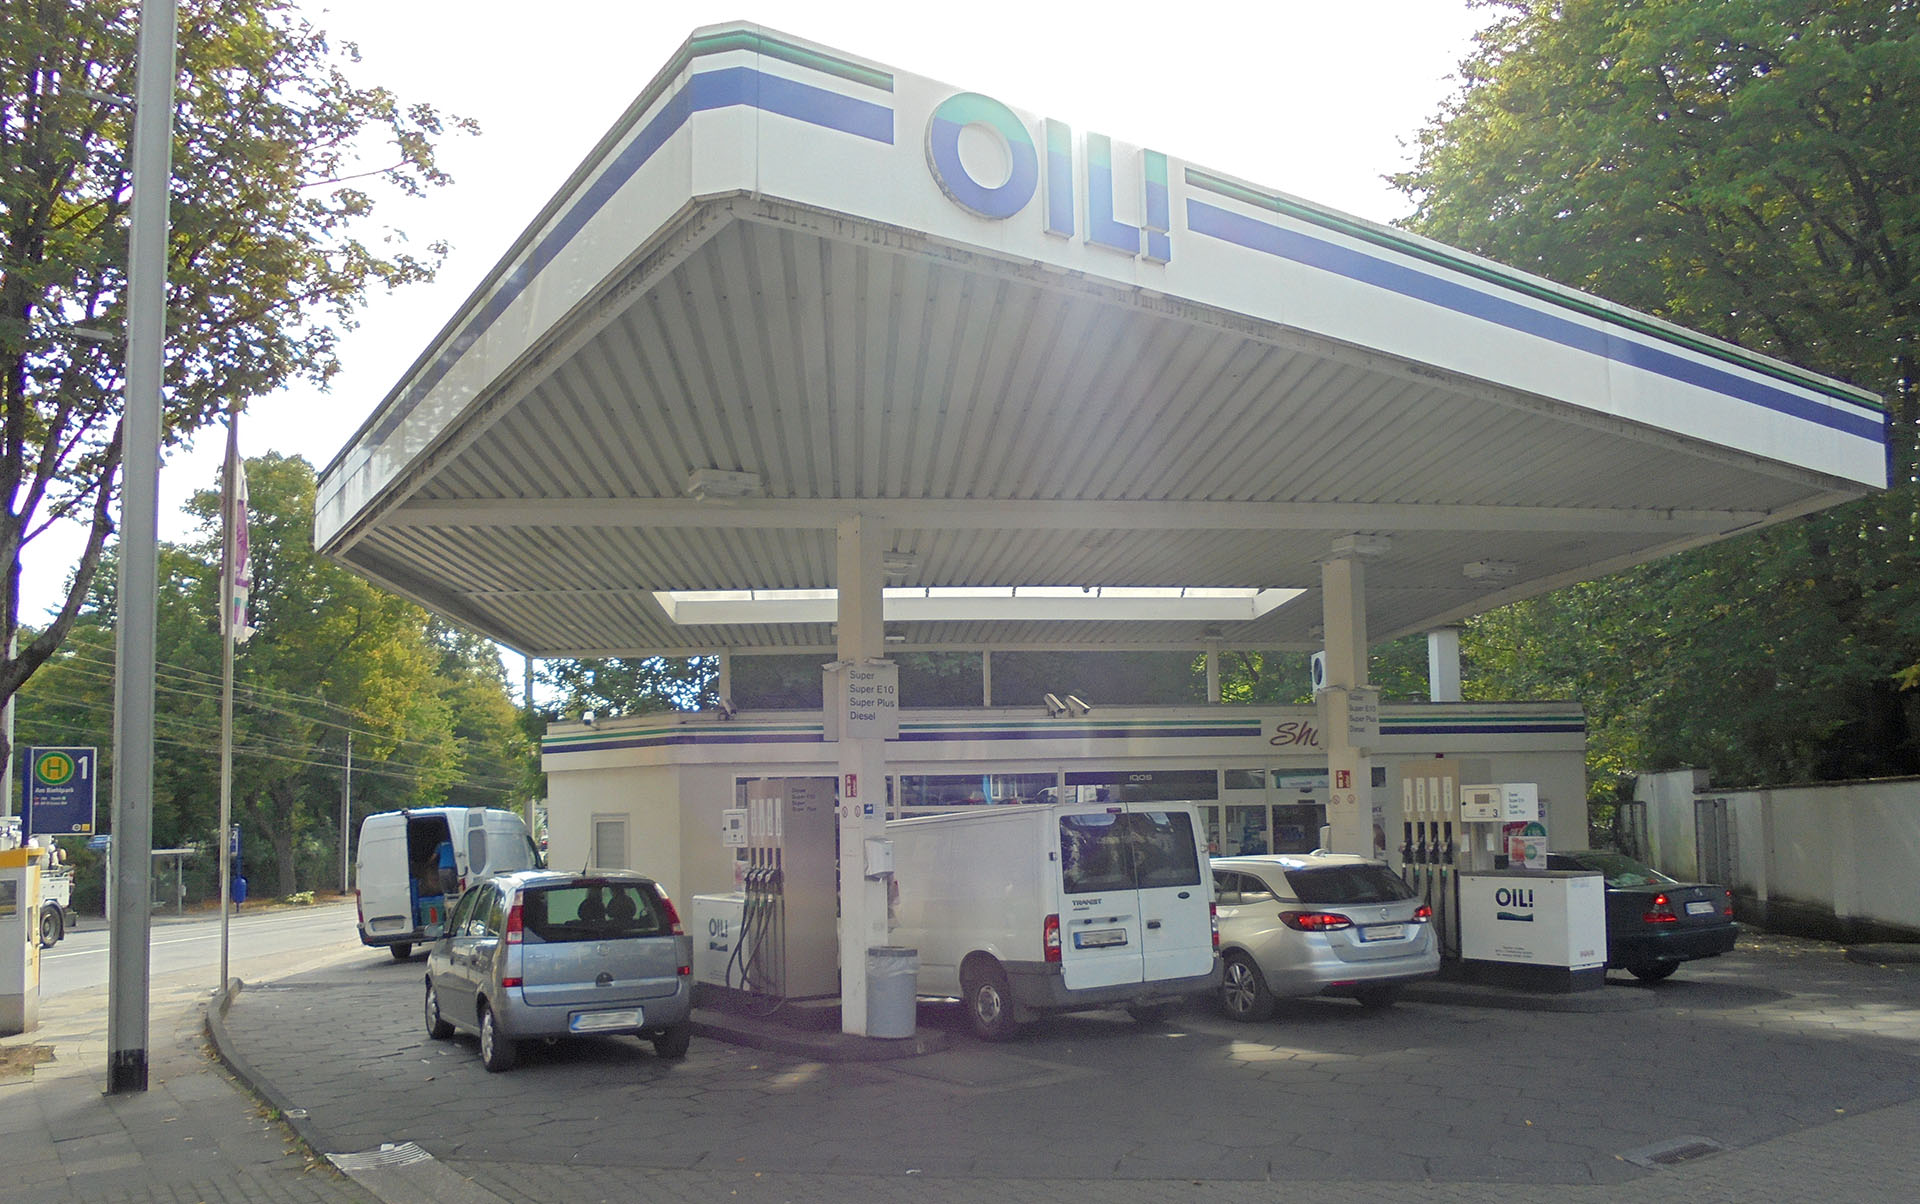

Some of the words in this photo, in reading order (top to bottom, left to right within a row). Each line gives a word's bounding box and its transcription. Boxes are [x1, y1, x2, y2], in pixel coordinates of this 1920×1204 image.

[924, 91, 1172, 265] OIL!
[849, 670, 875, 680] Super
[849, 683, 874, 694] Super
[876, 685, 895, 694] E10
[849, 696, 875, 707] Super
[877, 698, 895, 708] Plus
[850, 711, 876, 720] Diesel
[77, 756, 88, 779] 1
[1492, 808, 1499, 818] 3
[1071, 898, 1102, 906] TRANSIT
[1495, 887, 1534, 908] OIL!
[709, 918, 728, 938] OIL!
